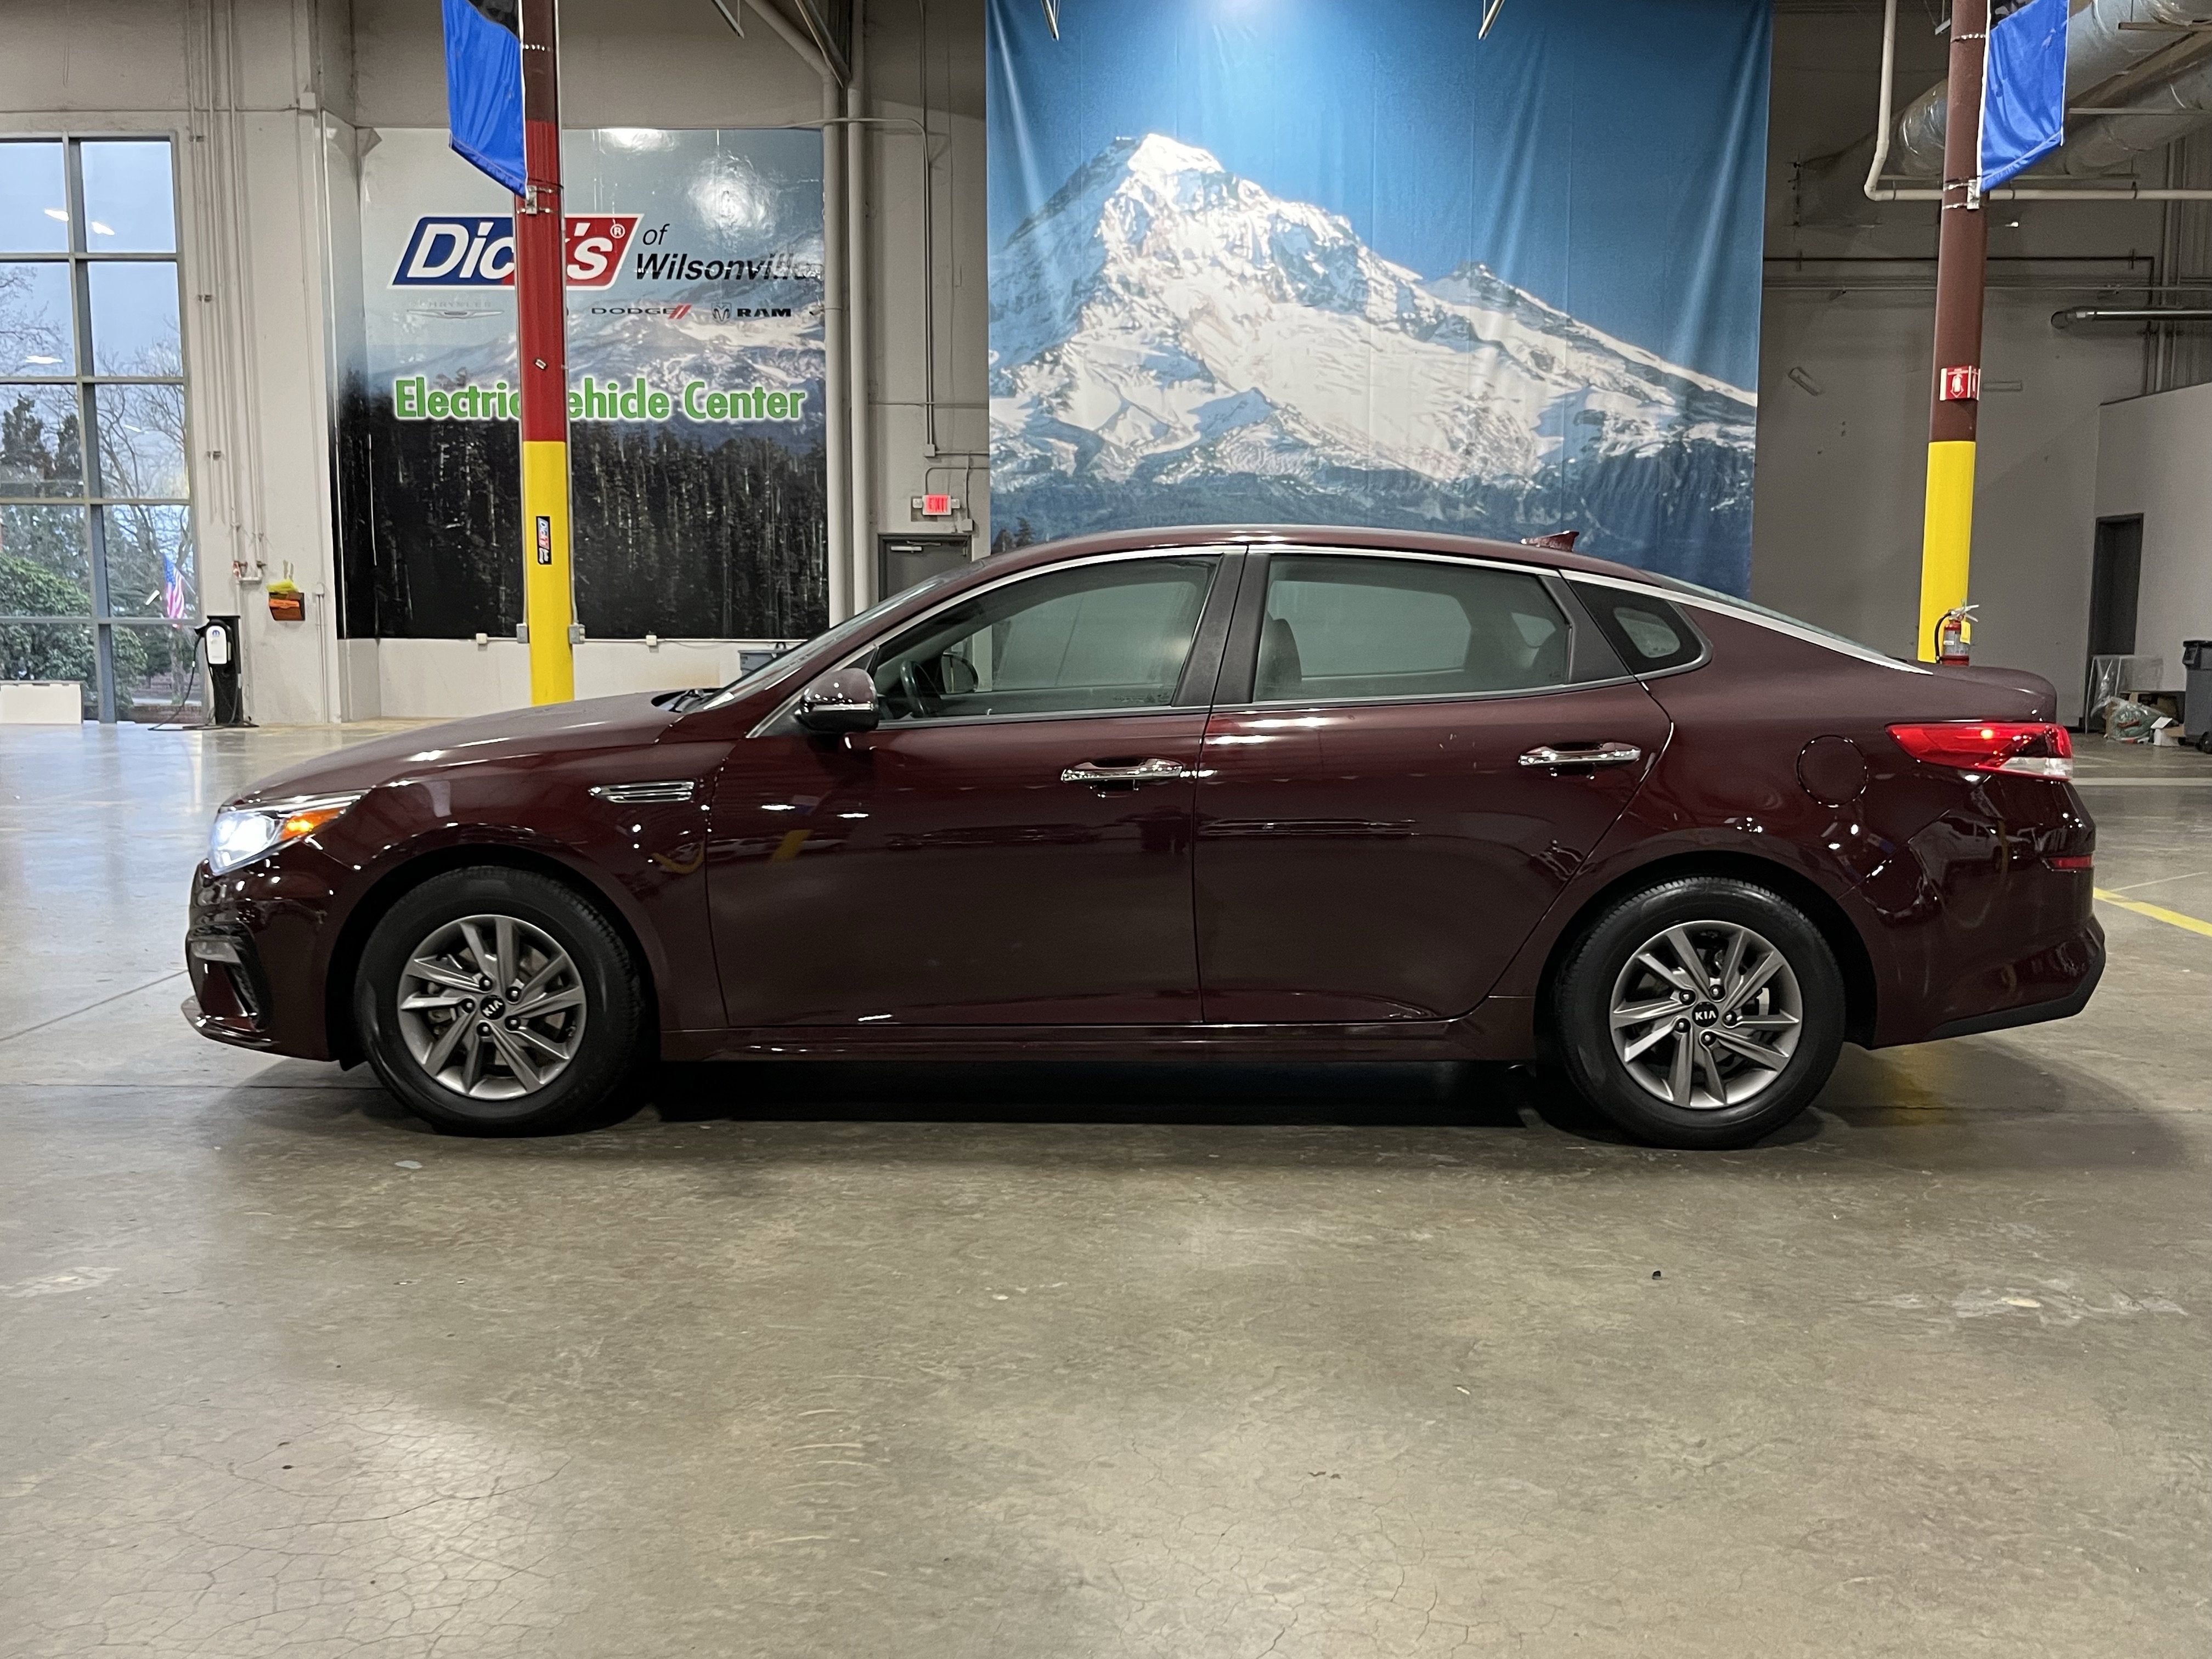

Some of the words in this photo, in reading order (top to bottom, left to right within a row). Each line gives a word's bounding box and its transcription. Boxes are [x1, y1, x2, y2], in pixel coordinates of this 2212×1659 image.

[642, 223, 670, 245] of
[737, 308, 792, 318] RAM
[569, 377, 670, 419] ehicle
[684, 381, 805, 419] Center
[482, 1000, 503, 1017] KIA
[1695, 1010, 1717, 1020] KIA
